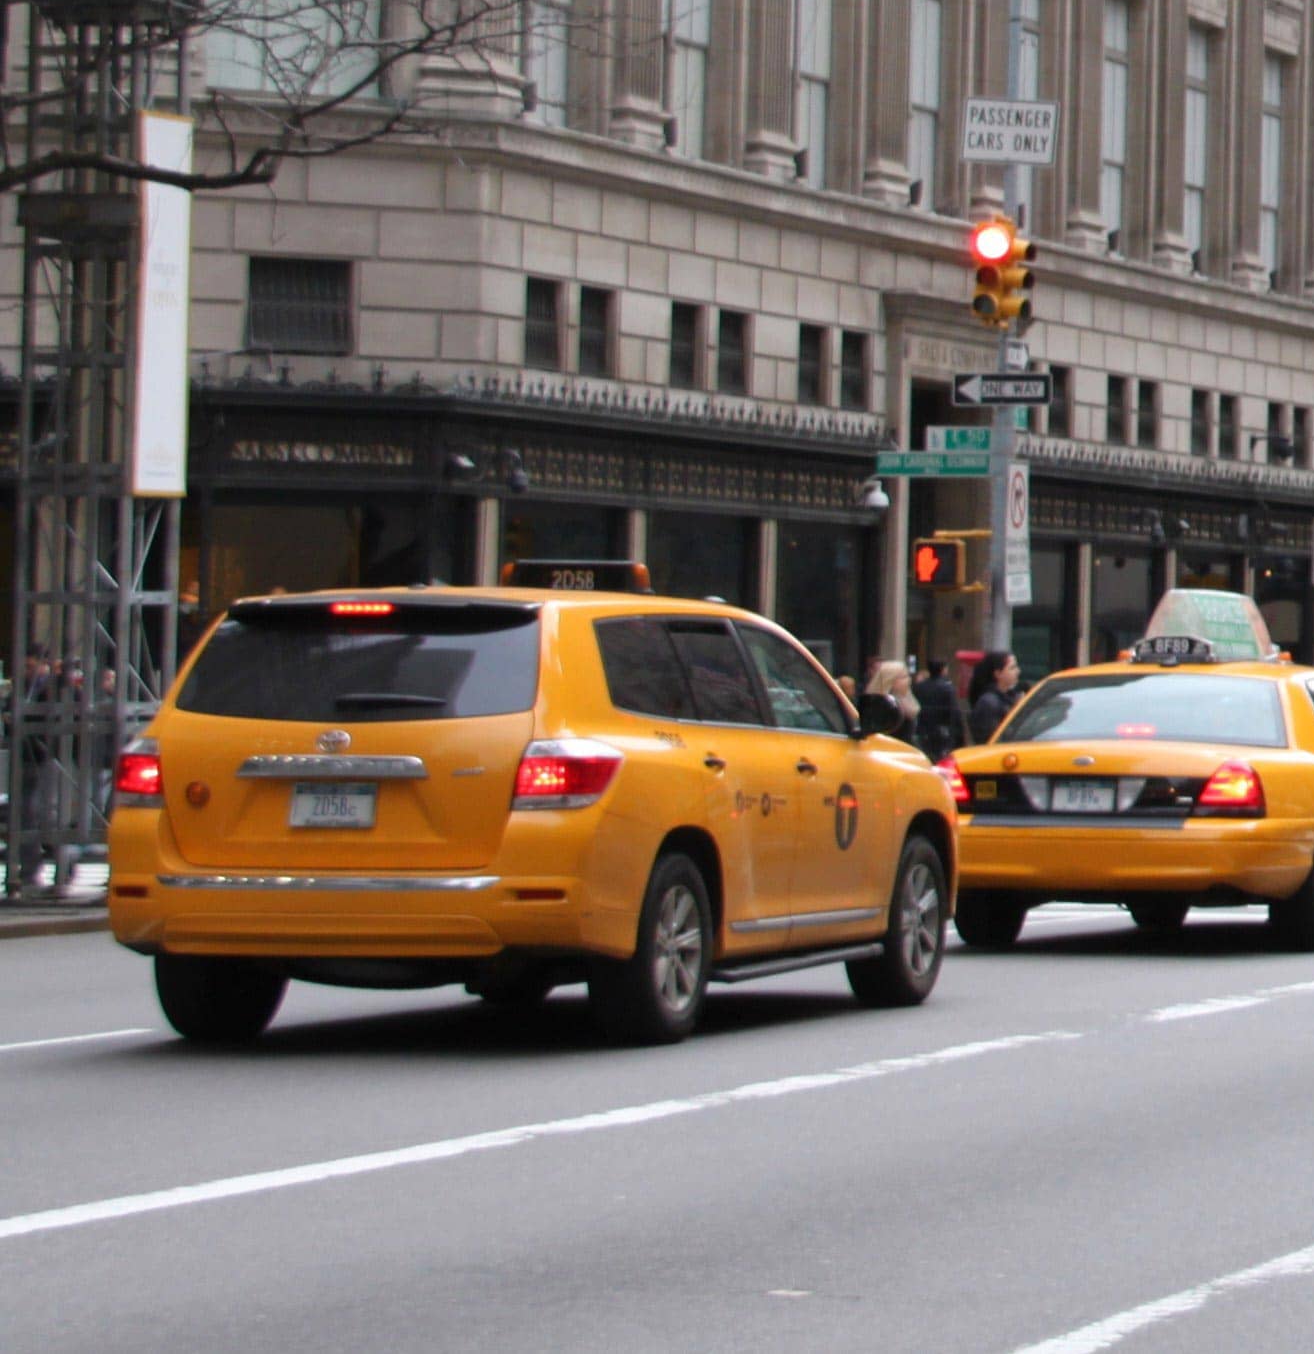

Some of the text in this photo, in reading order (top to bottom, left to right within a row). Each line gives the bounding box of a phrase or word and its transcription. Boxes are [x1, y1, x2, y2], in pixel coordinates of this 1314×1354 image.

[969, 107, 1052, 128] PASSENGER
[967, 131, 1049, 153] CARS ONLY
[982, 383, 1042, 395] ONE WAY
[551, 569, 595, 590] 2D58
